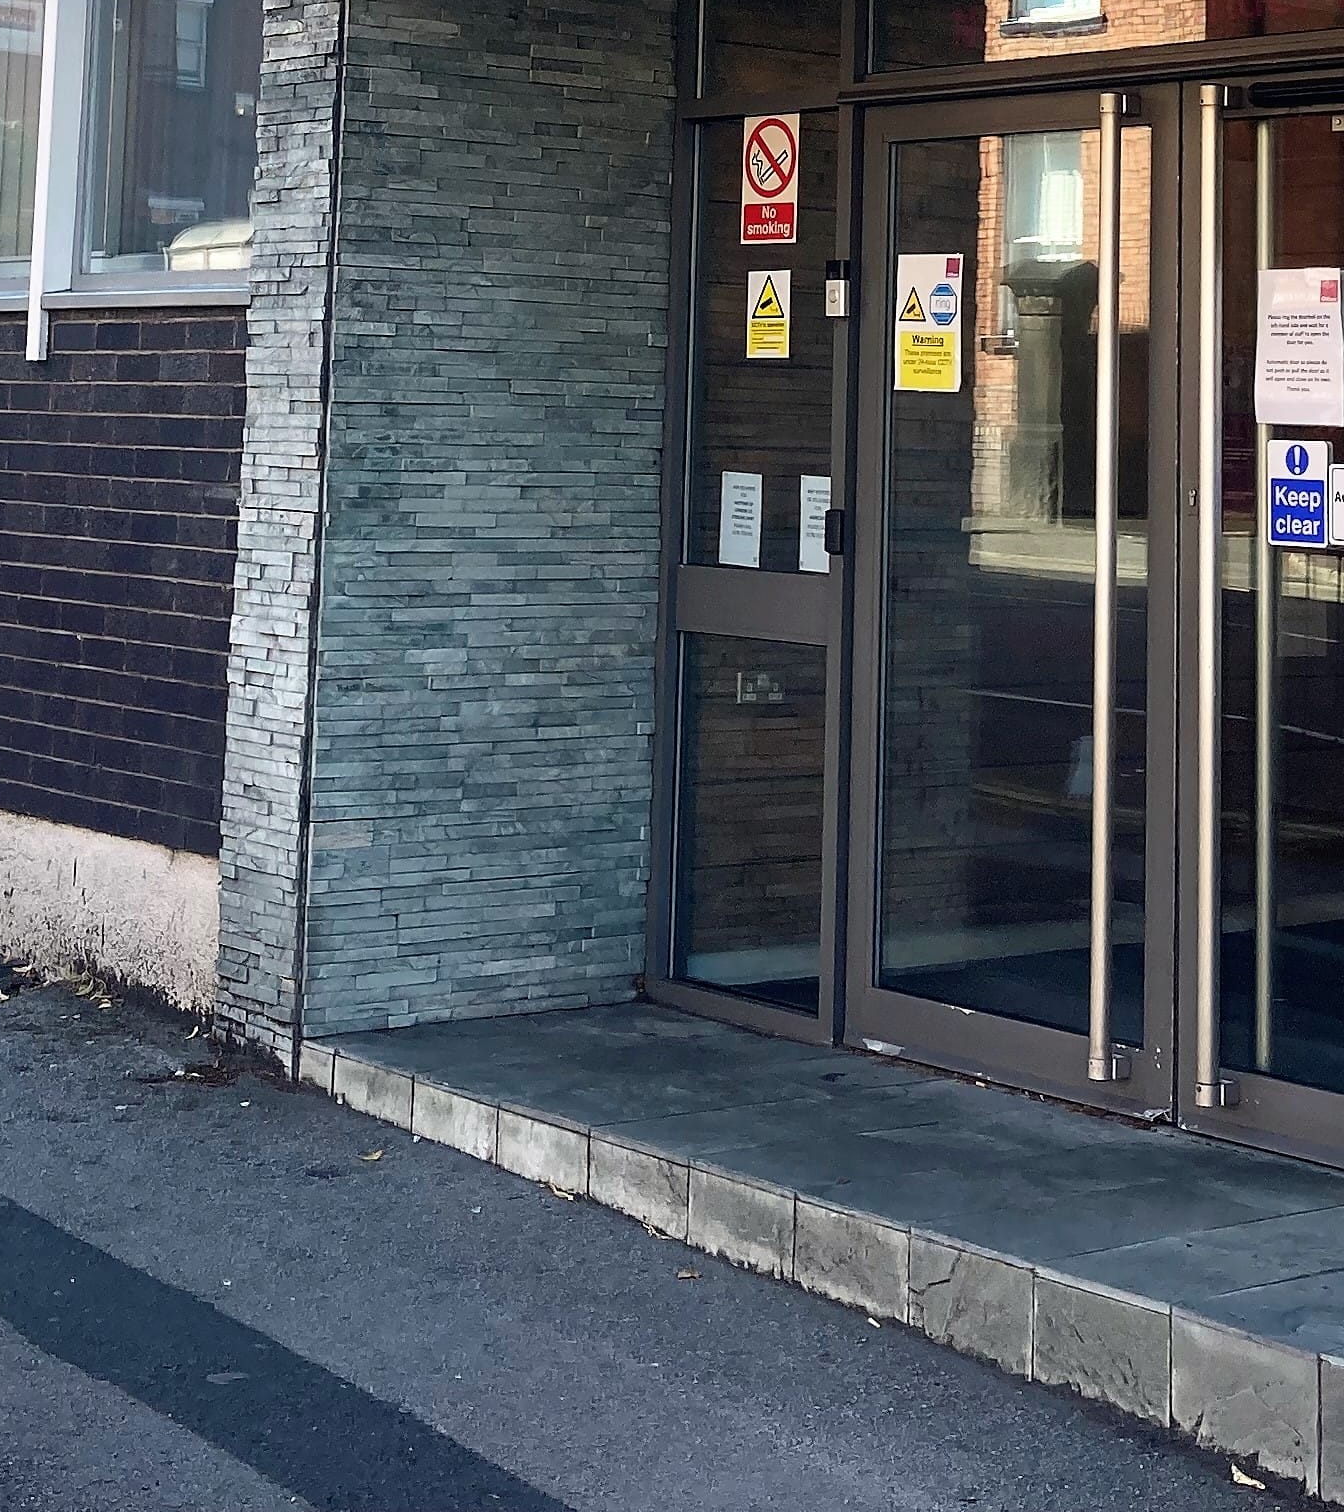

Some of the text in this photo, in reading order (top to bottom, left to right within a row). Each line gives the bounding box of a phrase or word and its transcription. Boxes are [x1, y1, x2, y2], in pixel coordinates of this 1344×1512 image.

[761, 205, 777, 219] No
[747, 220, 791, 238] smoking
[935, 297, 951, 311] ring
[912, 334, 944, 345] Warning
[1274, 485, 1322, 513] Keep
[1275, 514, 1321, 536] clear
